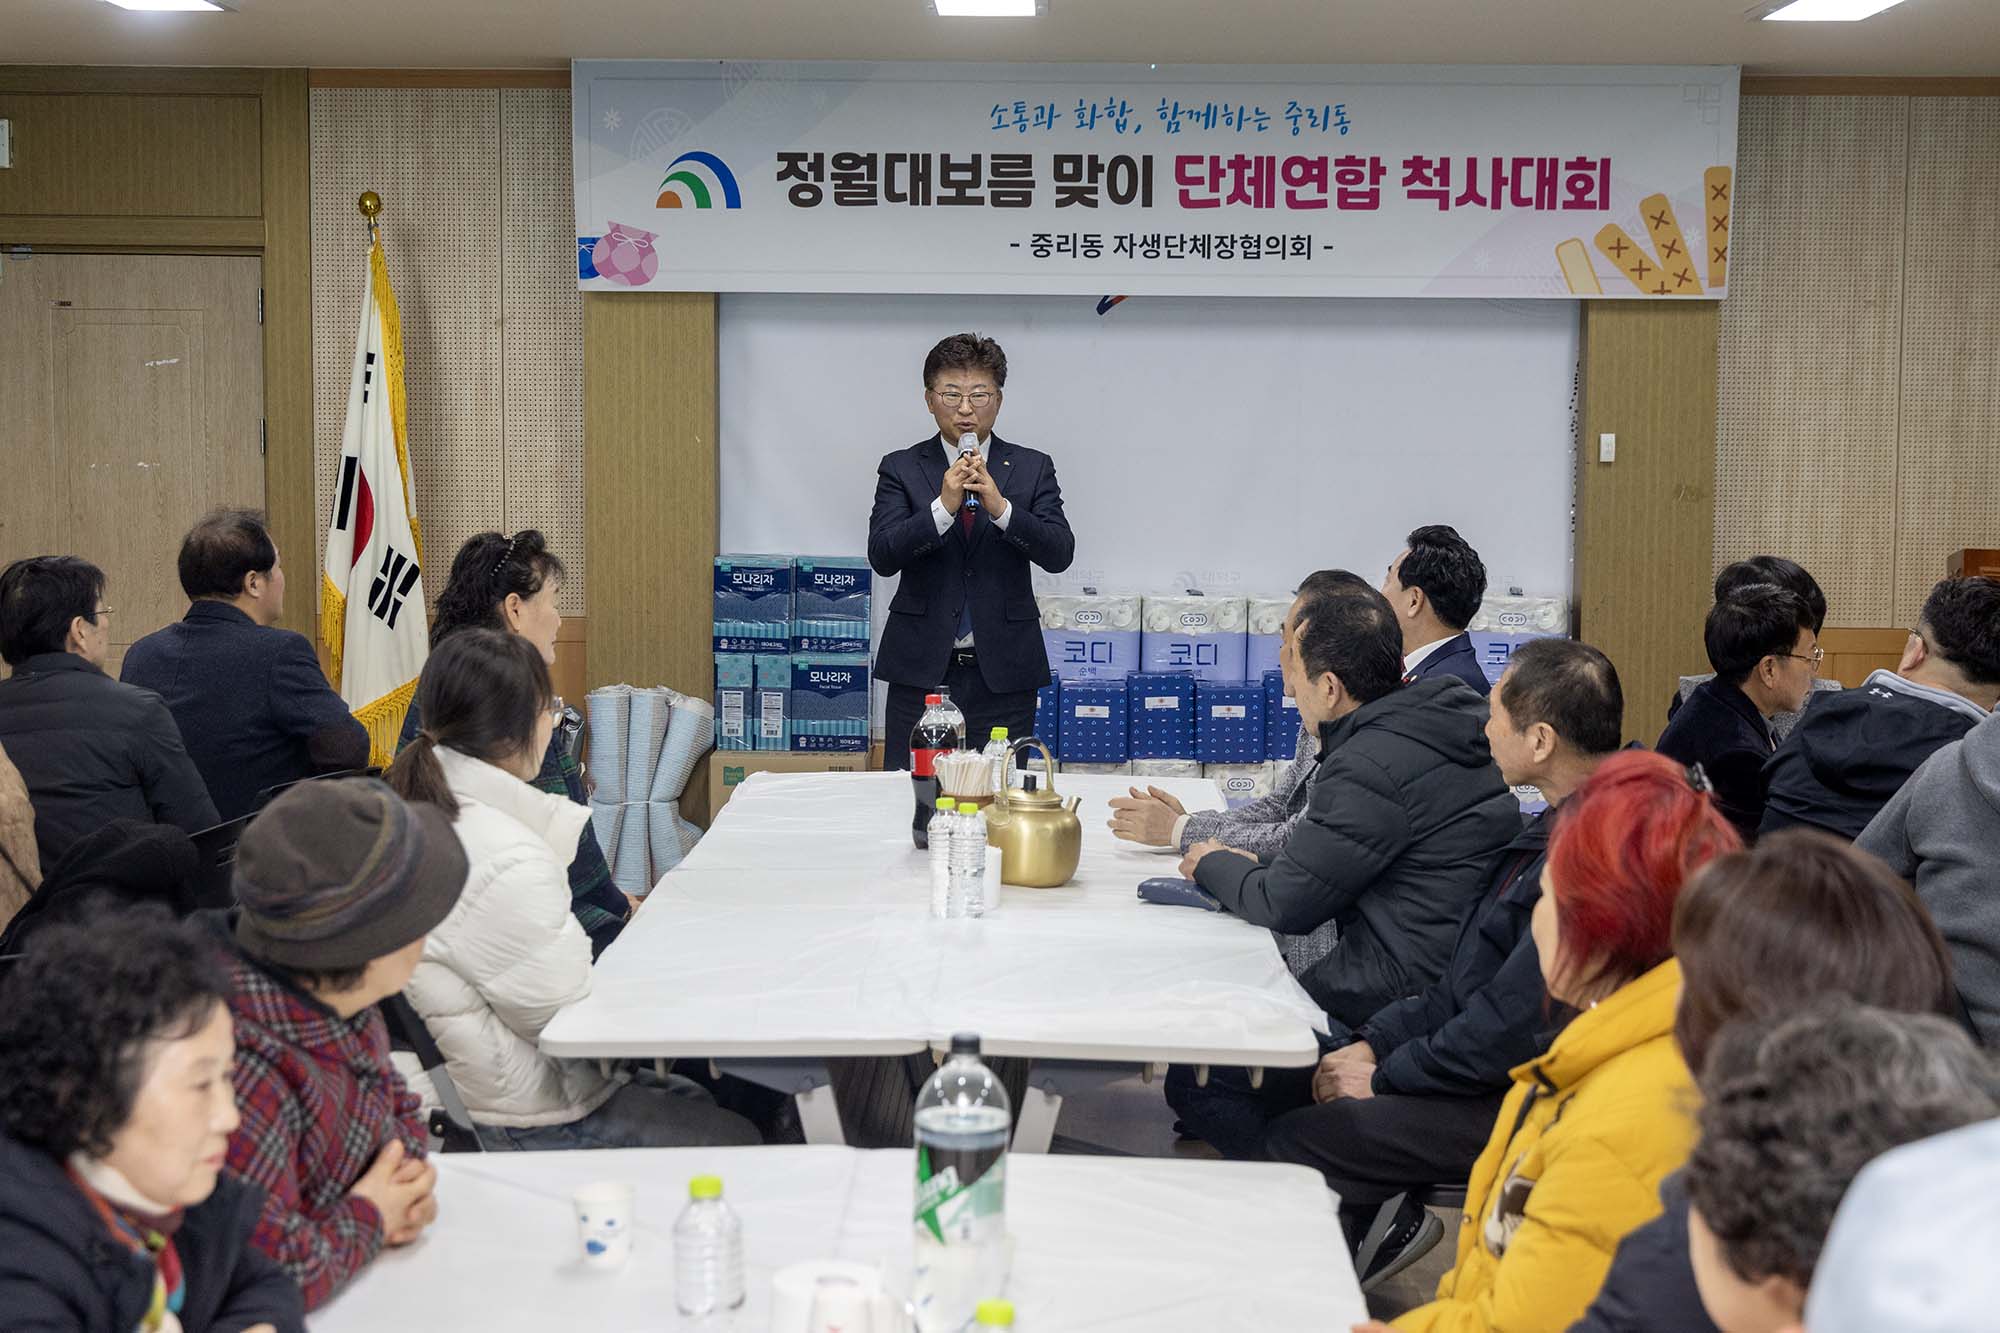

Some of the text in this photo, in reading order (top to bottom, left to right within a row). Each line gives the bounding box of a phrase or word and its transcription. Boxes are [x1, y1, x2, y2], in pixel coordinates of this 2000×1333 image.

[991, 96, 1352, 137] 소통과 화합, 함께하는 중리동
[775, 151, 1611, 212] 정월대보름 맞이 단체연합 척사대회
[1030, 232, 1104, 259] 중리동
[1112, 232, 1313, 261] 자생단체장협의회
[732, 573, 775, 586] 모나리자
[814, 573, 856, 586] 모나리자
[1063, 641, 1113, 664] 코디
[1168, 643, 1218, 666] 코디
[1487, 643, 1522, 665] 코
[810, 671, 852, 684] 모나리자
